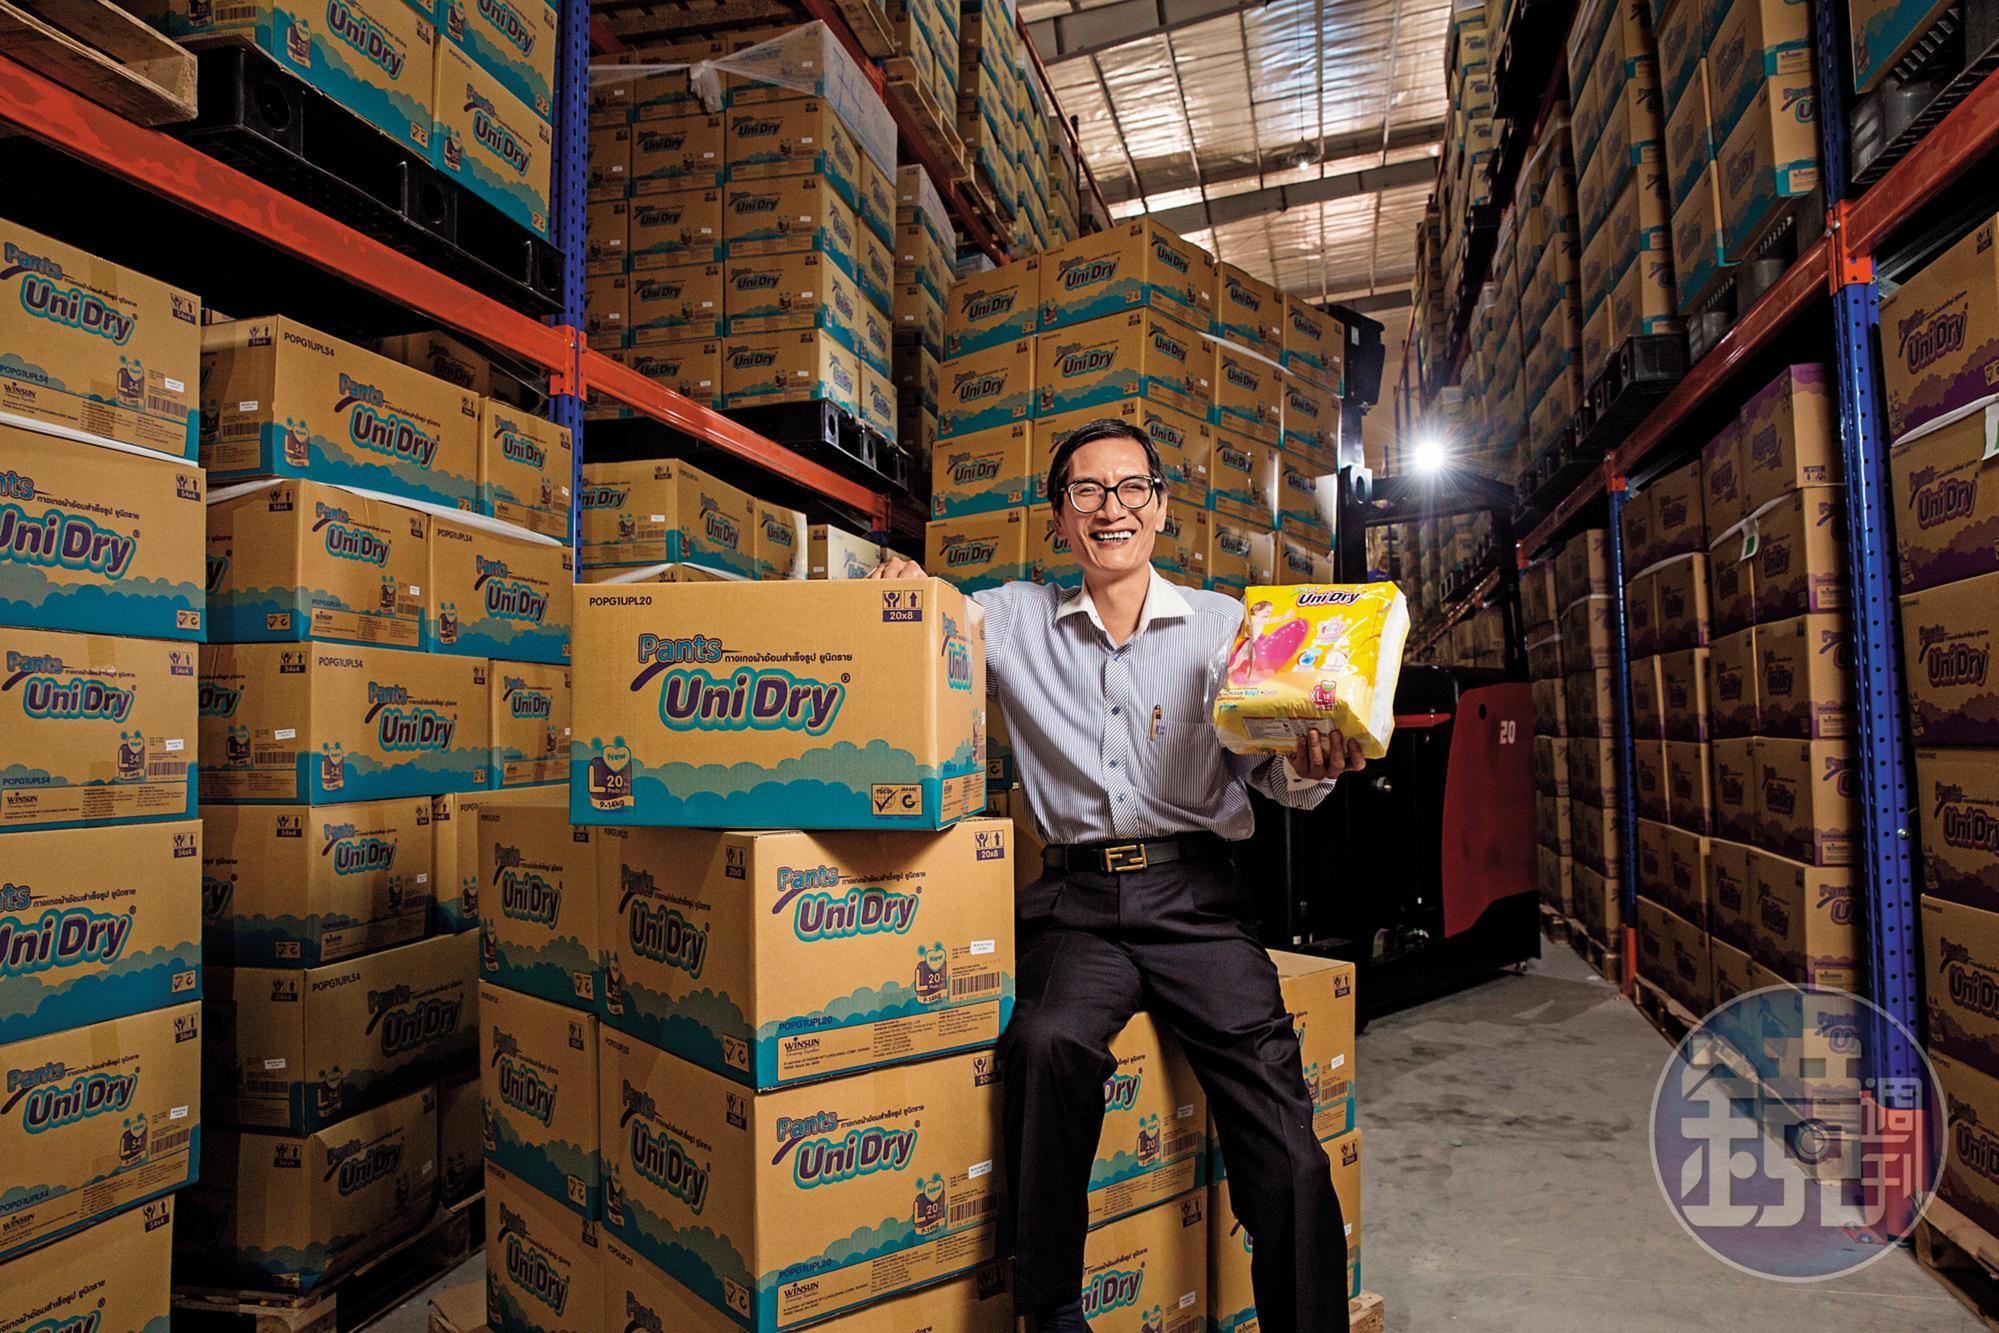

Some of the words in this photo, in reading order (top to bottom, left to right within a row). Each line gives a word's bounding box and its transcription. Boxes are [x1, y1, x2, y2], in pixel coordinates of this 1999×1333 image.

[589, 596, 653, 606] POPG1UPL20
[1297, 591, 1361, 608] UniDry
[889, 610, 914, 621] 20x8
[638, 633, 723, 663] Pants
[318, 656, 364, 669] POPG1UPL54
[664, 671, 841, 730] UniDry
[1499, 720, 1516, 744] 20
[607, 752, 627, 761] New
[606, 774, 625, 788] 20
[980, 848, 1001, 859] 20x8
[776, 866, 839, 891] Pants
[797, 892, 917, 935] UniDry
[928, 972, 942, 984] 20
[784, 1036, 820, 1051] WINSUN
[776, 1110, 838, 1142] Pants
[797, 1130, 916, 1181] UniDry
[926, 1203, 939, 1215] 20
[784, 1282, 820, 1299] WINSUN
